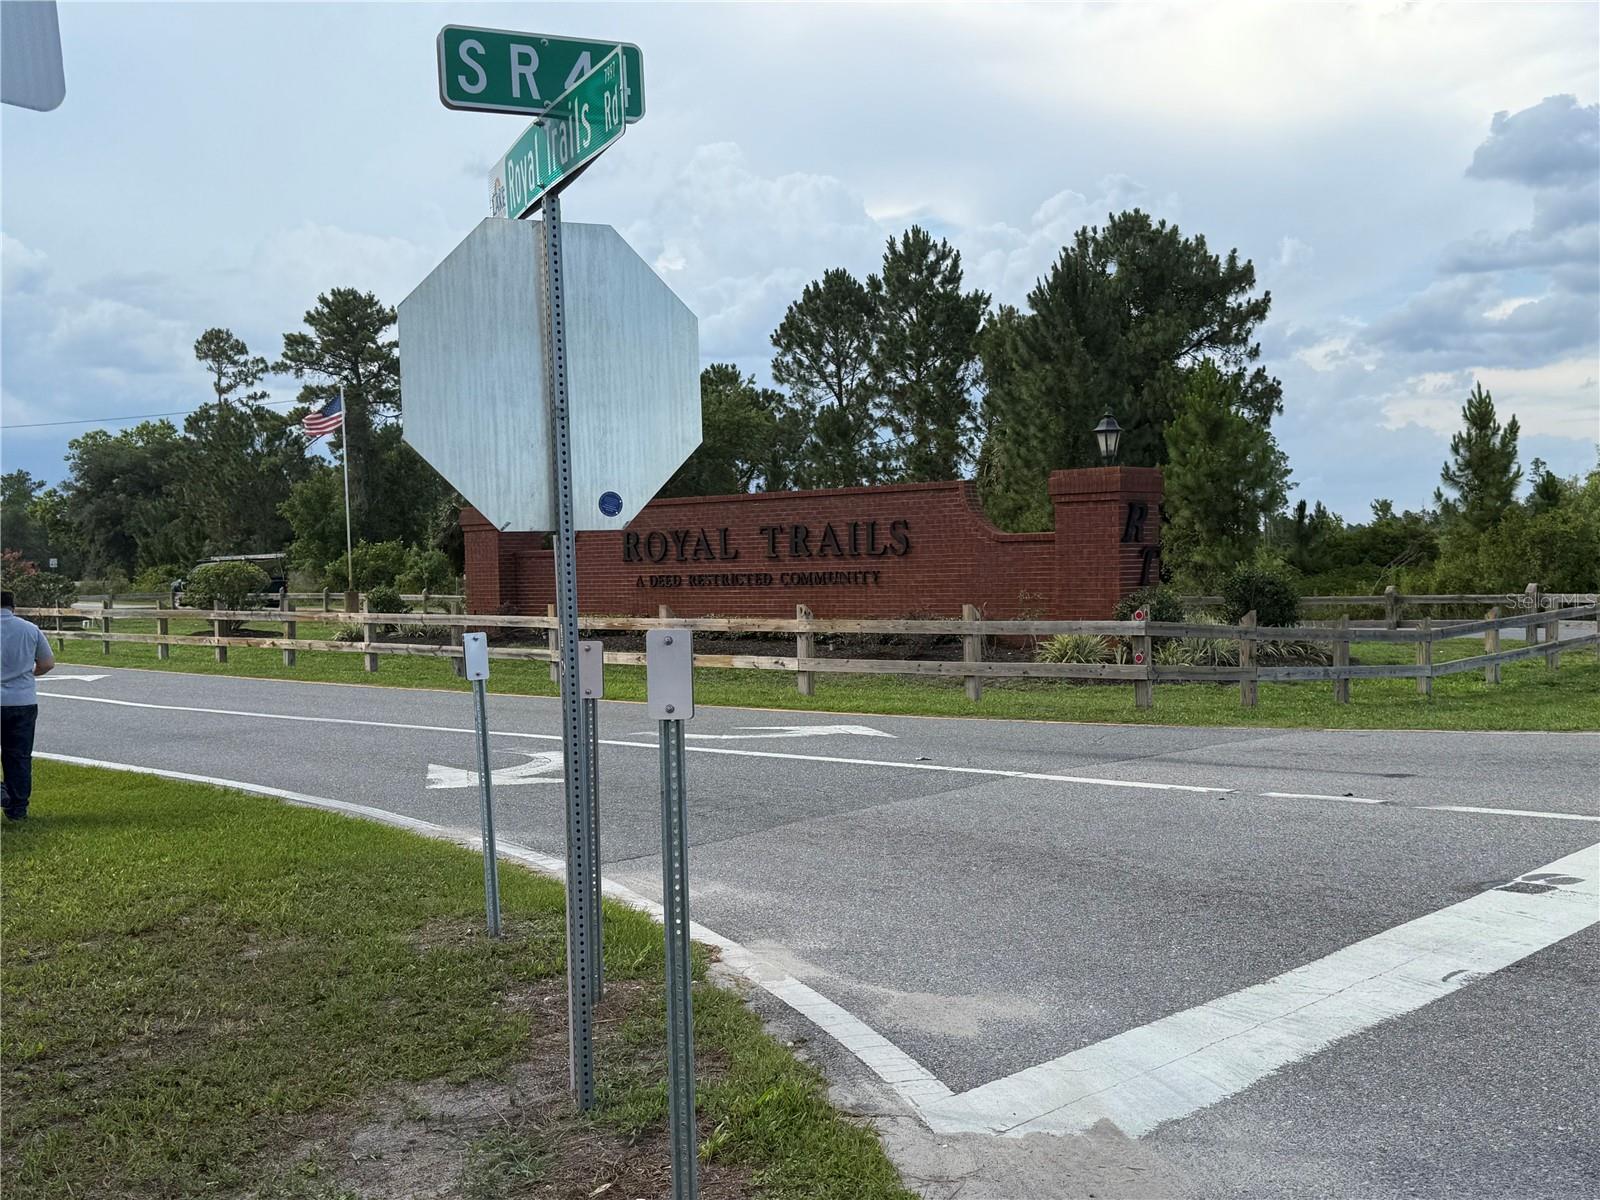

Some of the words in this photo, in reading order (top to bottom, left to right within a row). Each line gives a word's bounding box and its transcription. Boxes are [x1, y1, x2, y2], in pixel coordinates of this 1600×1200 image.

[458, 39, 487, 94] S
[510, 43, 541, 100] R
[508, 131, 541, 212] Royal
[543, 96, 592, 176] Trails
[604, 84, 619, 132] Rd
[623, 527, 739, 562] ROYAL
[760, 520, 912, 558] TRAILS
[1121, 502, 1149, 543] R
[636, 575, 645, 588] A
[649, 574, 682, 588] DEED
[687, 572, 773, 587] RESTRICTED
[781, 570, 880, 586] COMMUNITY
[1138, 547, 1161, 587] T
